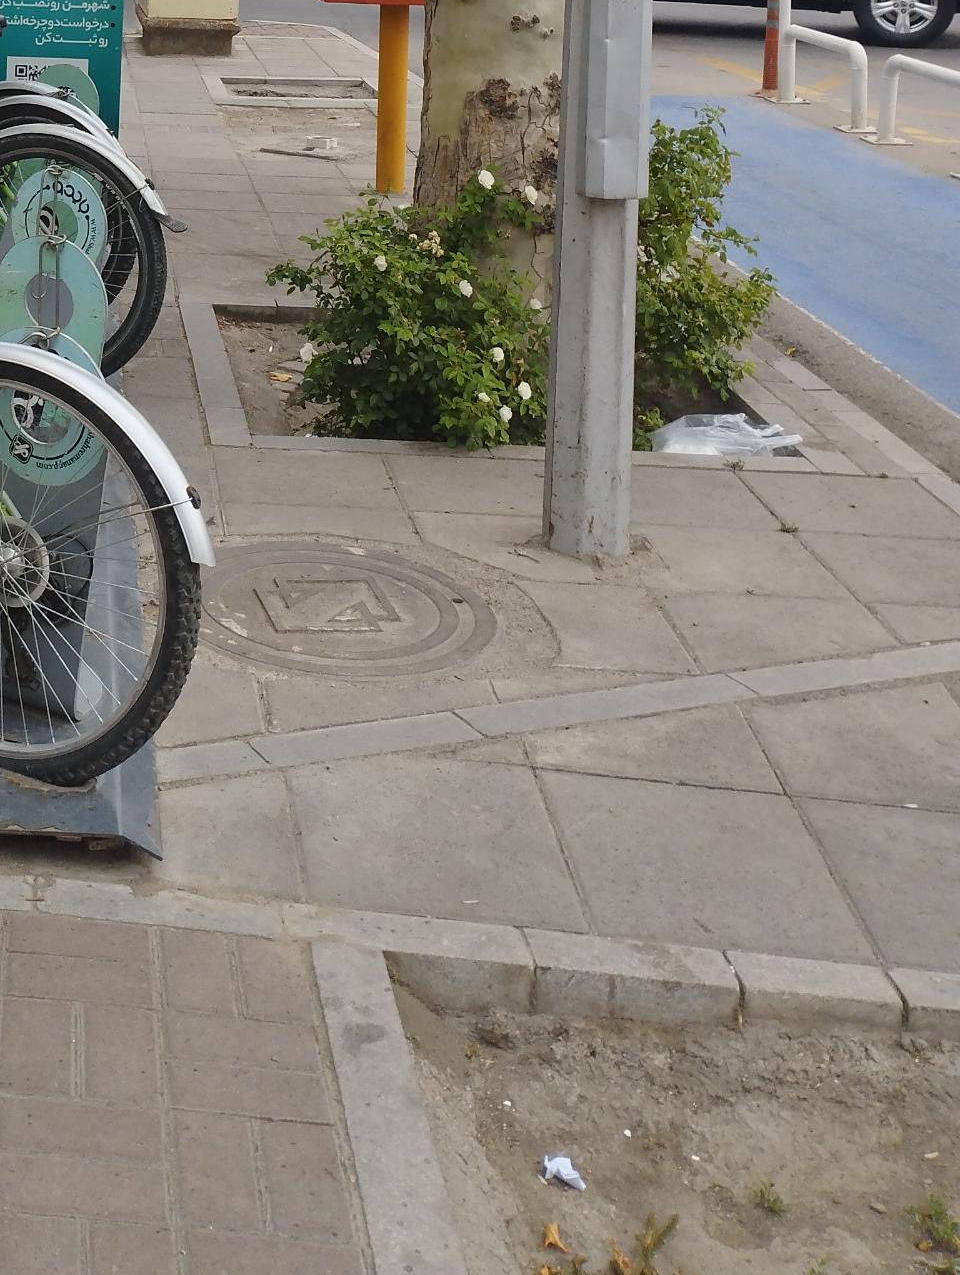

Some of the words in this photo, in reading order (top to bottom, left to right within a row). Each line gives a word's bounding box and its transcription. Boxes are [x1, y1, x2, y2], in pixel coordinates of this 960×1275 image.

[50, 0, 60, 11] رو
[60, 18, 109, 31] درخواست
[35, 32, 53, 45] کن
[52, 34, 98, 46] ثبت
[98, 36, 108, 47] رو
